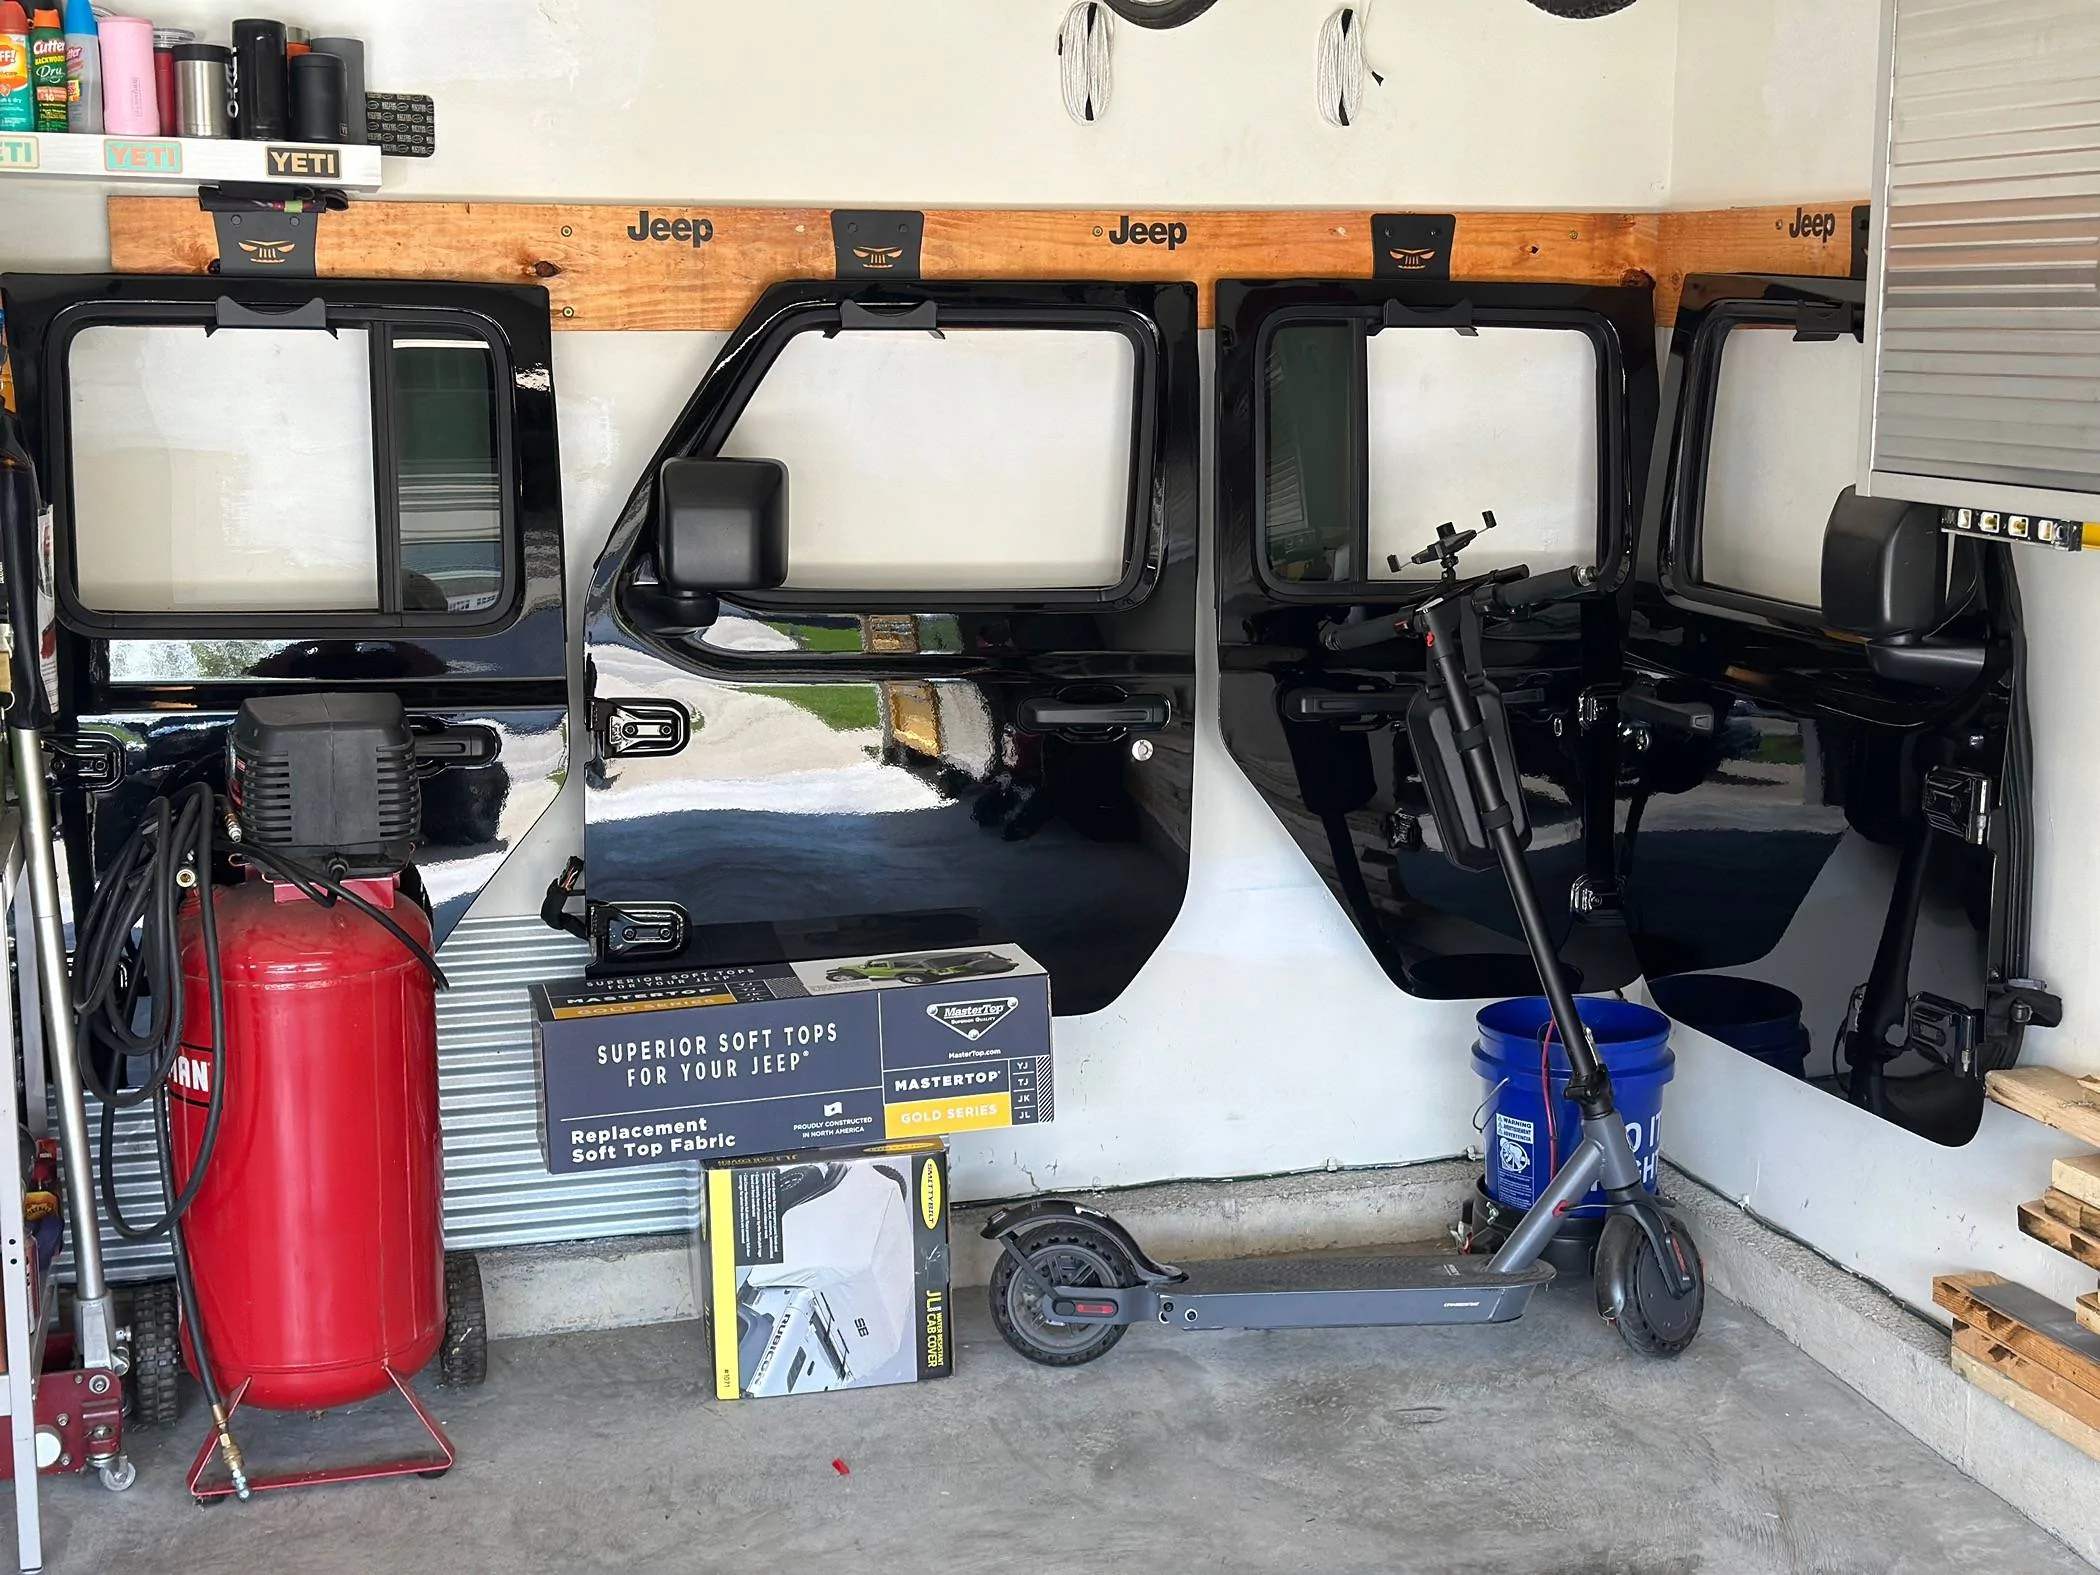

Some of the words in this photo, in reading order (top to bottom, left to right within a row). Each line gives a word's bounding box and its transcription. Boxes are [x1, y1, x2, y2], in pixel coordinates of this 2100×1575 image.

[0, 141, 32, 162] TI
[111, 146, 175, 167] YETI
[270, 152, 335, 174] YETI
[627, 211, 713, 248] Jeep
[1109, 215, 1187, 250] Jeep
[1789, 207, 1835, 243] Jeep
[586, 975, 662, 987] SUPERIOR
[671, 971, 708, 980] SOFT
[717, 968, 755, 976] TOPS
[648, 979, 686, 988] YOUR
[576, 1005, 636, 1016] GOLD
[649, 998, 716, 1011] SERIES
[944, 1004, 1004, 1018] MasterTop
[597, 1035, 707, 1065] SUPERIOR
[719, 1028, 772, 1053] SOFT
[783, 1022, 837, 1047] TOPS
[948, 1049, 1002, 1059] MasterTop.com
[627, 1066, 667, 1087] FOR
[680, 1058, 737, 1082] YOUR
[1017, 1062, 1028, 1070] YJ
[1018, 1078, 1029, 1086] TJ
[1017, 1094, 1030, 1103] JK
[793, 1121, 823, 1131] PROUDLY
[825, 1116, 873, 1127] CONSTRUCTED
[901, 1110, 941, 1124] GOLD
[947, 1104, 997, 1119] SERIES
[1018, 1111, 1030, 1119] JL
[1503, 1117, 1532, 1129] WARNING
[571, 1117, 708, 1145] Replacement
[811, 1129, 834, 1137] NORTH
[835, 1126, 865, 1135] AMERICA
[572, 1145, 616, 1163] Soft
[624, 1142, 663, 1157] Top
[670, 1132, 736, 1153] Fabric
[926, 1163, 935, 1224] SMITTYBILT
[854, 1317, 870, 1337] SB
[926, 1313, 937, 1334] CAB
[754, 1313, 791, 1386] RUBICON
[927, 1335, 938, 1368] COVER
